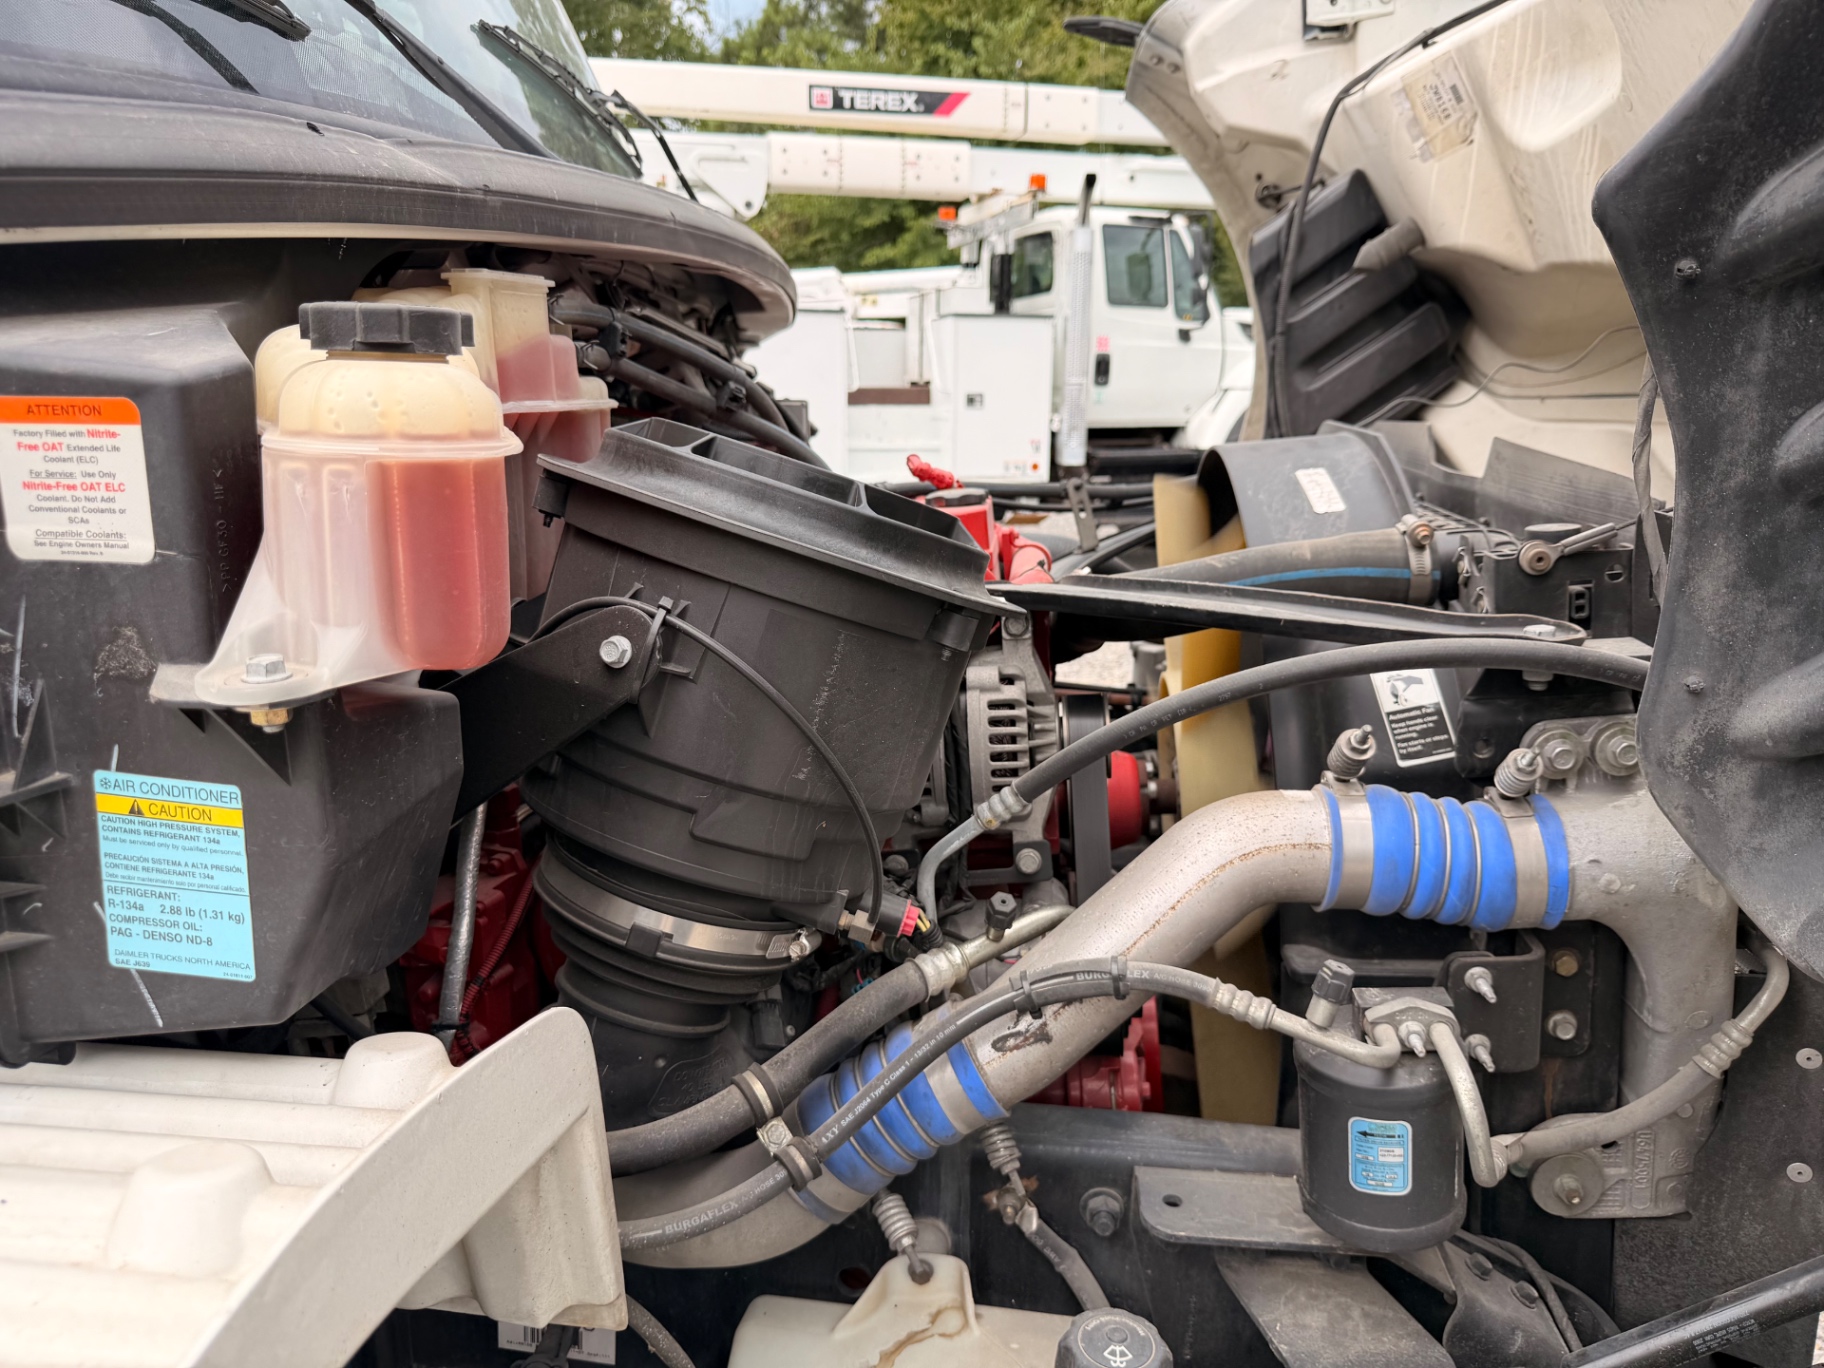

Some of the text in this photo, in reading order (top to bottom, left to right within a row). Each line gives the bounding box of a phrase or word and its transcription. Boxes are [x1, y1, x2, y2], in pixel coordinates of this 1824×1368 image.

[838, 88, 918, 112] TEREX
[27, 404, 102, 416] ATTENTION
[13, 429, 43, 439] Factory
[86, 429, 121, 438] Nitrite-
[17, 442, 121, 452] Free OAT Extended Life
[43, 455, 98, 465] Coolant (ELC)
[30, 469, 116, 480] For Service: Use Only
[22, 481, 125, 492] Nitrite-Free OAT ELC
[37, 494, 69, 502] Coolant.
[72, 495, 82, 503] Do
[84, 495, 98, 503] Not
[29, 505, 80, 513] Conventional
[82, 506, 116, 514] Coolants
[68, 516, 89, 524] SCAs
[35, 529, 126, 539] Compatible Coolants:
[49, 541, 73, 549] Engine
[113, 778, 239, 805] AIR CONDITIONER
[149, 803, 212, 821] CAUTION
[101, 815, 240, 838] CAUTION HIGH PRESSURE SYSTEM,
[102, 825, 220, 845] CONTAINS REFRIGERANT 134a
[129, 838, 155, 847] serviced
[157, 841, 170, 849] only
[172, 843, 179, 851] by
[181, 844, 208, 853] qualified
[104, 852, 244, 874] PRECAUCIÓN SISTEMA A ALTA PRESIÓN,
[105, 862, 214, 880] CONTIENE REFRIGERANTE 134a
[107, 885, 181, 902] REFRIGERANT:
[197, 882, 219, 890] personal
[220, 884, 246, 893] calificado.
[109, 898, 245, 924] R-134a 2.88 lb (1.31 kg)
[109, 913, 202, 932] COMPRESSOR OIL:
[111, 926, 132, 938] PAG
[143, 929, 182, 943] DENSO
[186, 935, 213, 946] ND-8
[115, 949, 250, 970] DAIMLER TRUCKS NORTH AMERICA
[1076, 970, 1150, 981] BURGLEX
[840, 1114, 854, 1126] SAE
[854, 1097, 871, 1115] J2064
[871, 1086, 885, 1100] Type
[889, 1065, 906, 1080] Class
[914, 1044, 930, 1058] 13/32
[936, 1032, 944, 1040] 10
[944, 1024, 956, 1035] mm
[665, 1201, 739, 1234] BURGAFLEX
[754, 1178, 775, 1194] HOSE
